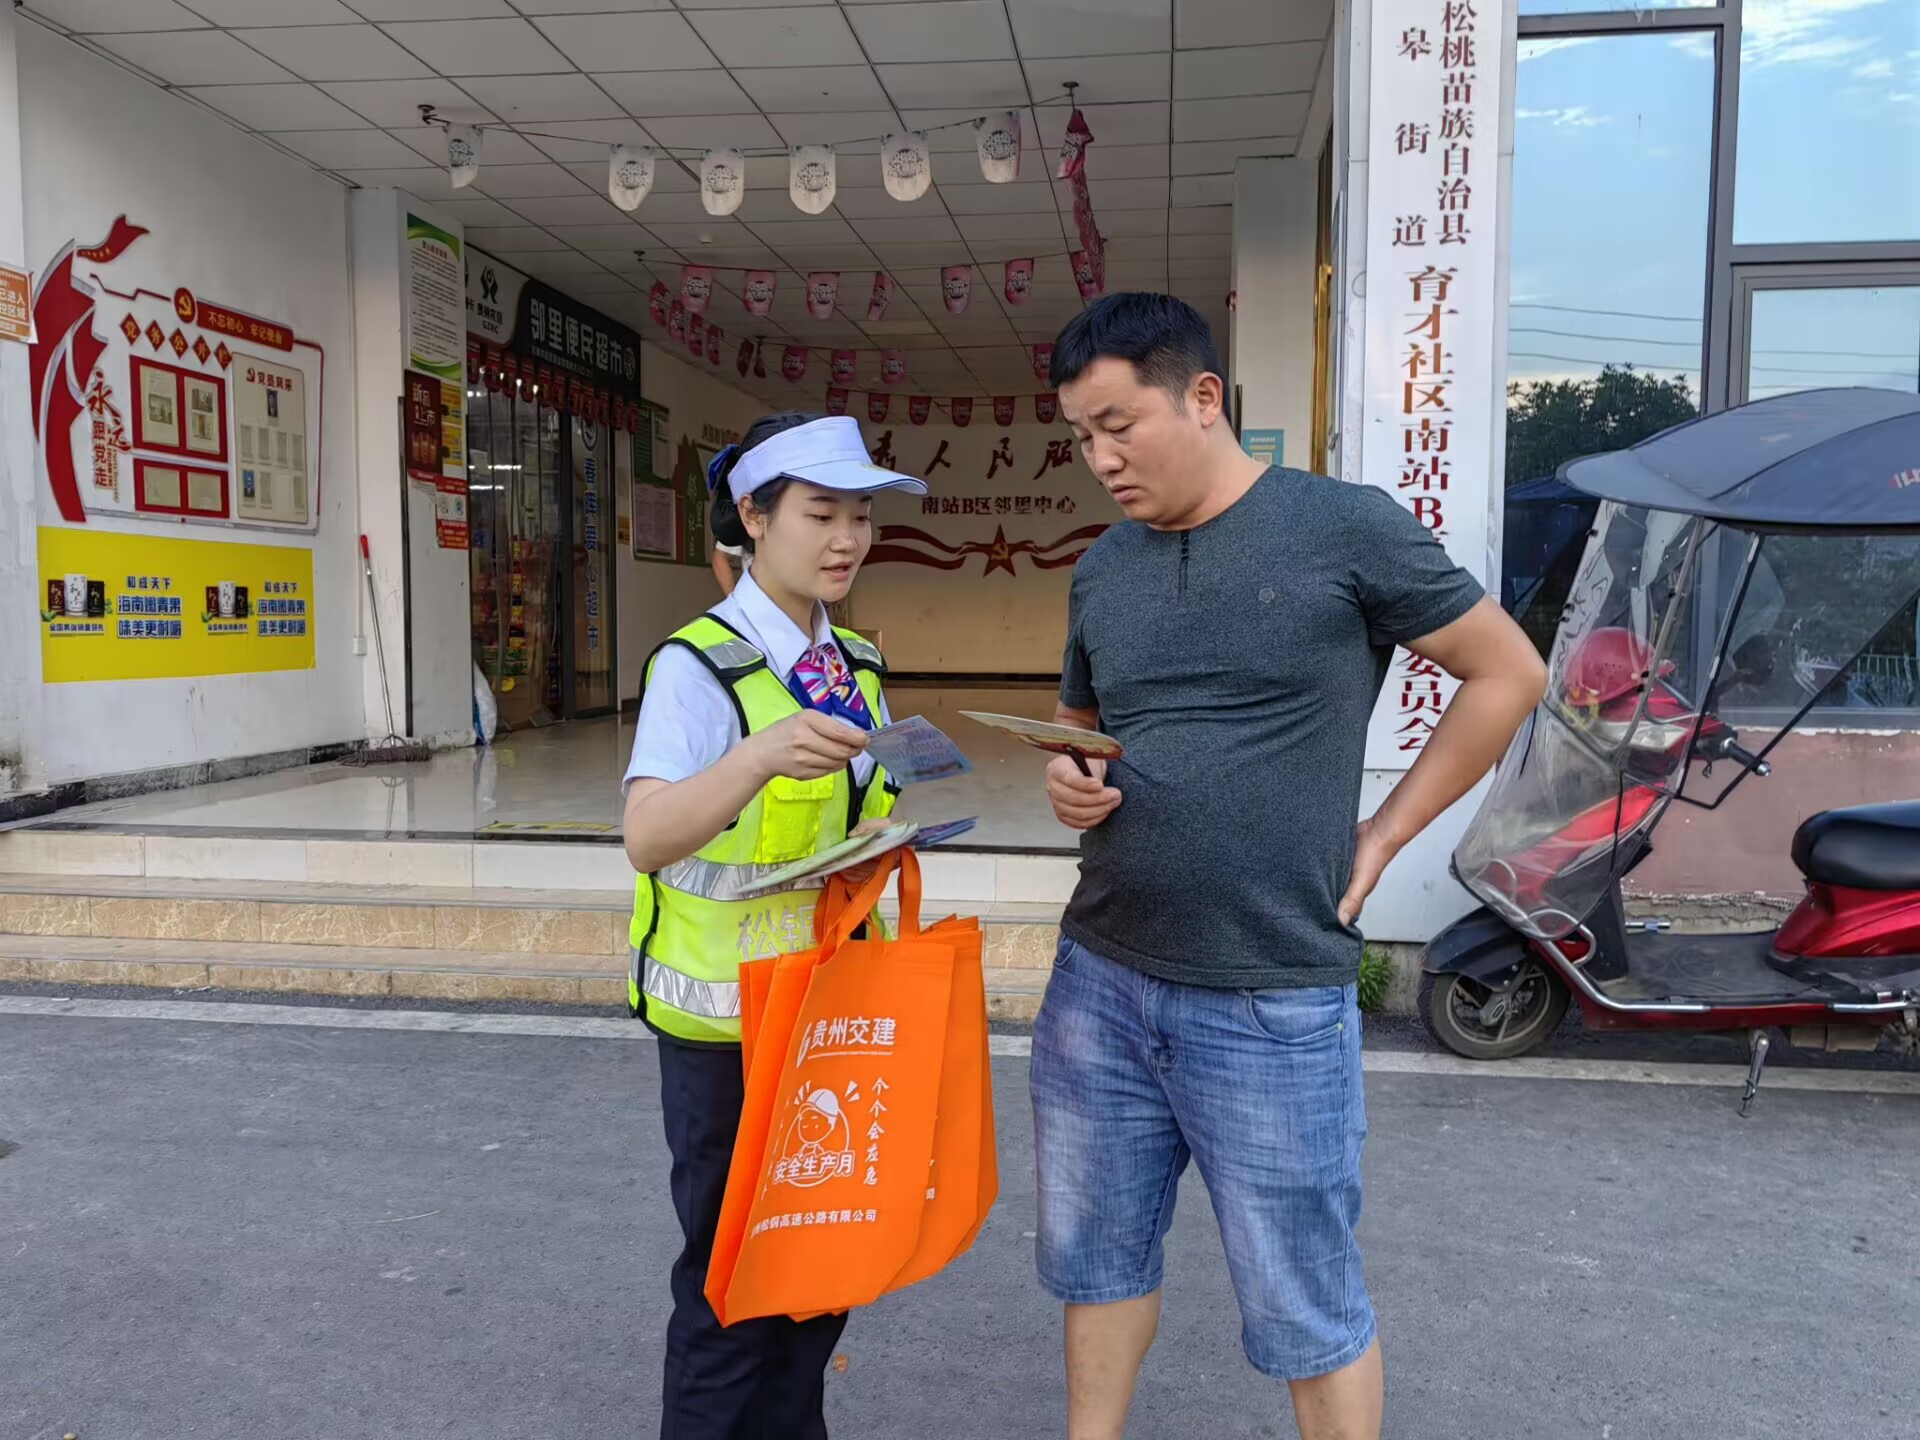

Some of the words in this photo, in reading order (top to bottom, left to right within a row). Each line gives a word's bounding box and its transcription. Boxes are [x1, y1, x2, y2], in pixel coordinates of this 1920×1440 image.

[1437, 0, 1478, 246] 松桃苗族自治县
[207, 310, 245, 334] 不忘初心
[529, 298, 623, 376] 邻里便民超市
[257, 370, 293, 392] 党员风采
[1397, 265, 1460, 544] 育才社区南站B
[869, 430, 1073, 480] 为人民服
[922, 495, 1076, 516] 南站B区邻里中心
[810, 1016, 896, 1049] 贵州交建
[863, 1077, 890, 1186] 个个会应急
[774, 1151, 855, 1184] 安全生产月
